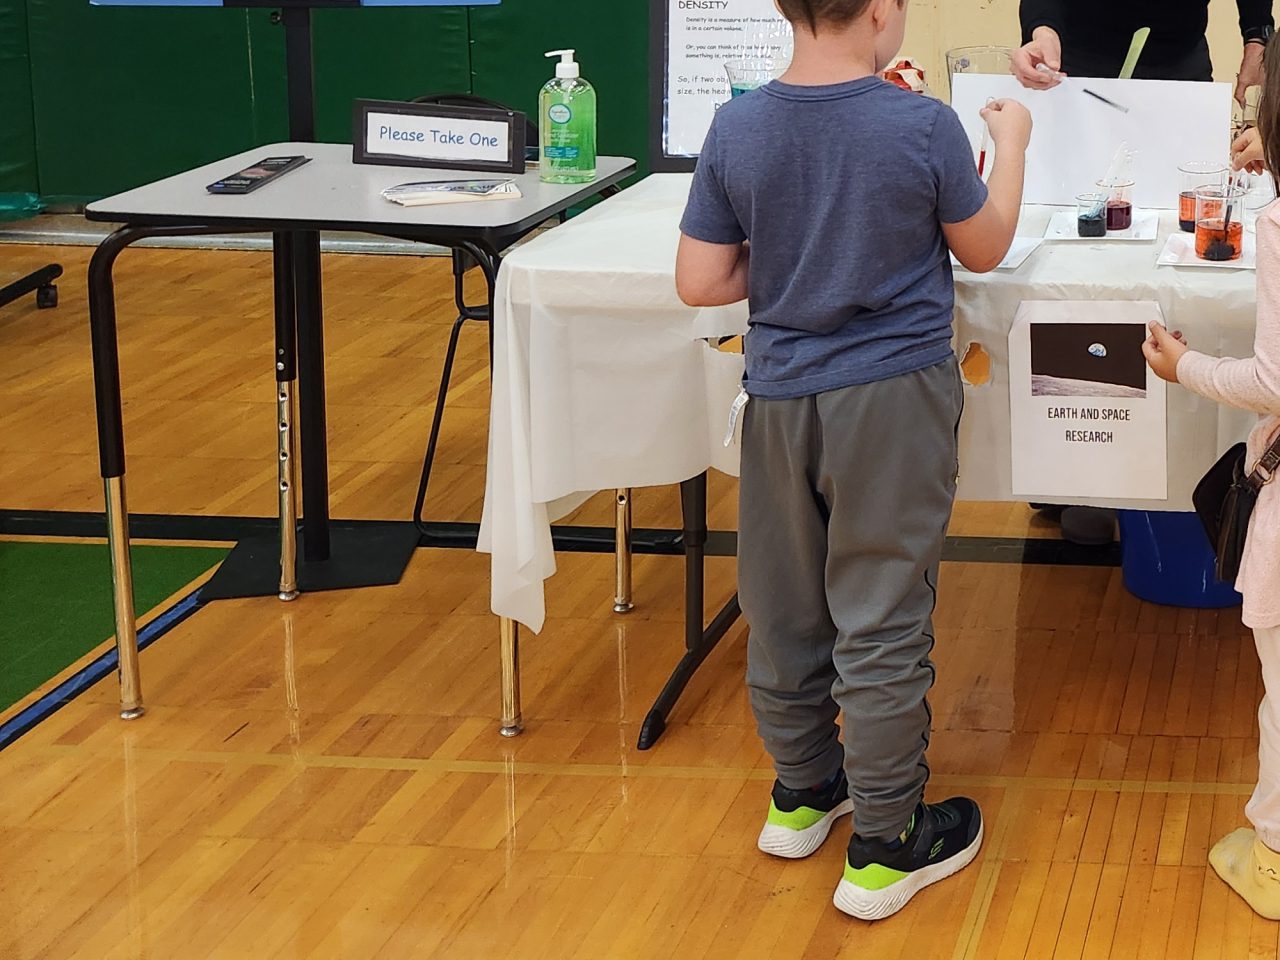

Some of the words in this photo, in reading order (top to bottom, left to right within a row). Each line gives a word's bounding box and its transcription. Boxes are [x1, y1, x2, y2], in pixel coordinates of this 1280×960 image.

[679, 1, 728, 9] DENSITY
[380, 126, 425, 142] Please
[430, 129, 464, 144] Take
[469, 132, 498, 147] One
[1048, 407, 1078, 419] EARTH
[1080, 408, 1099, 420] AND
[1102, 409, 1131, 421] SPACE
[1066, 430, 1113, 443] RESEARCH
